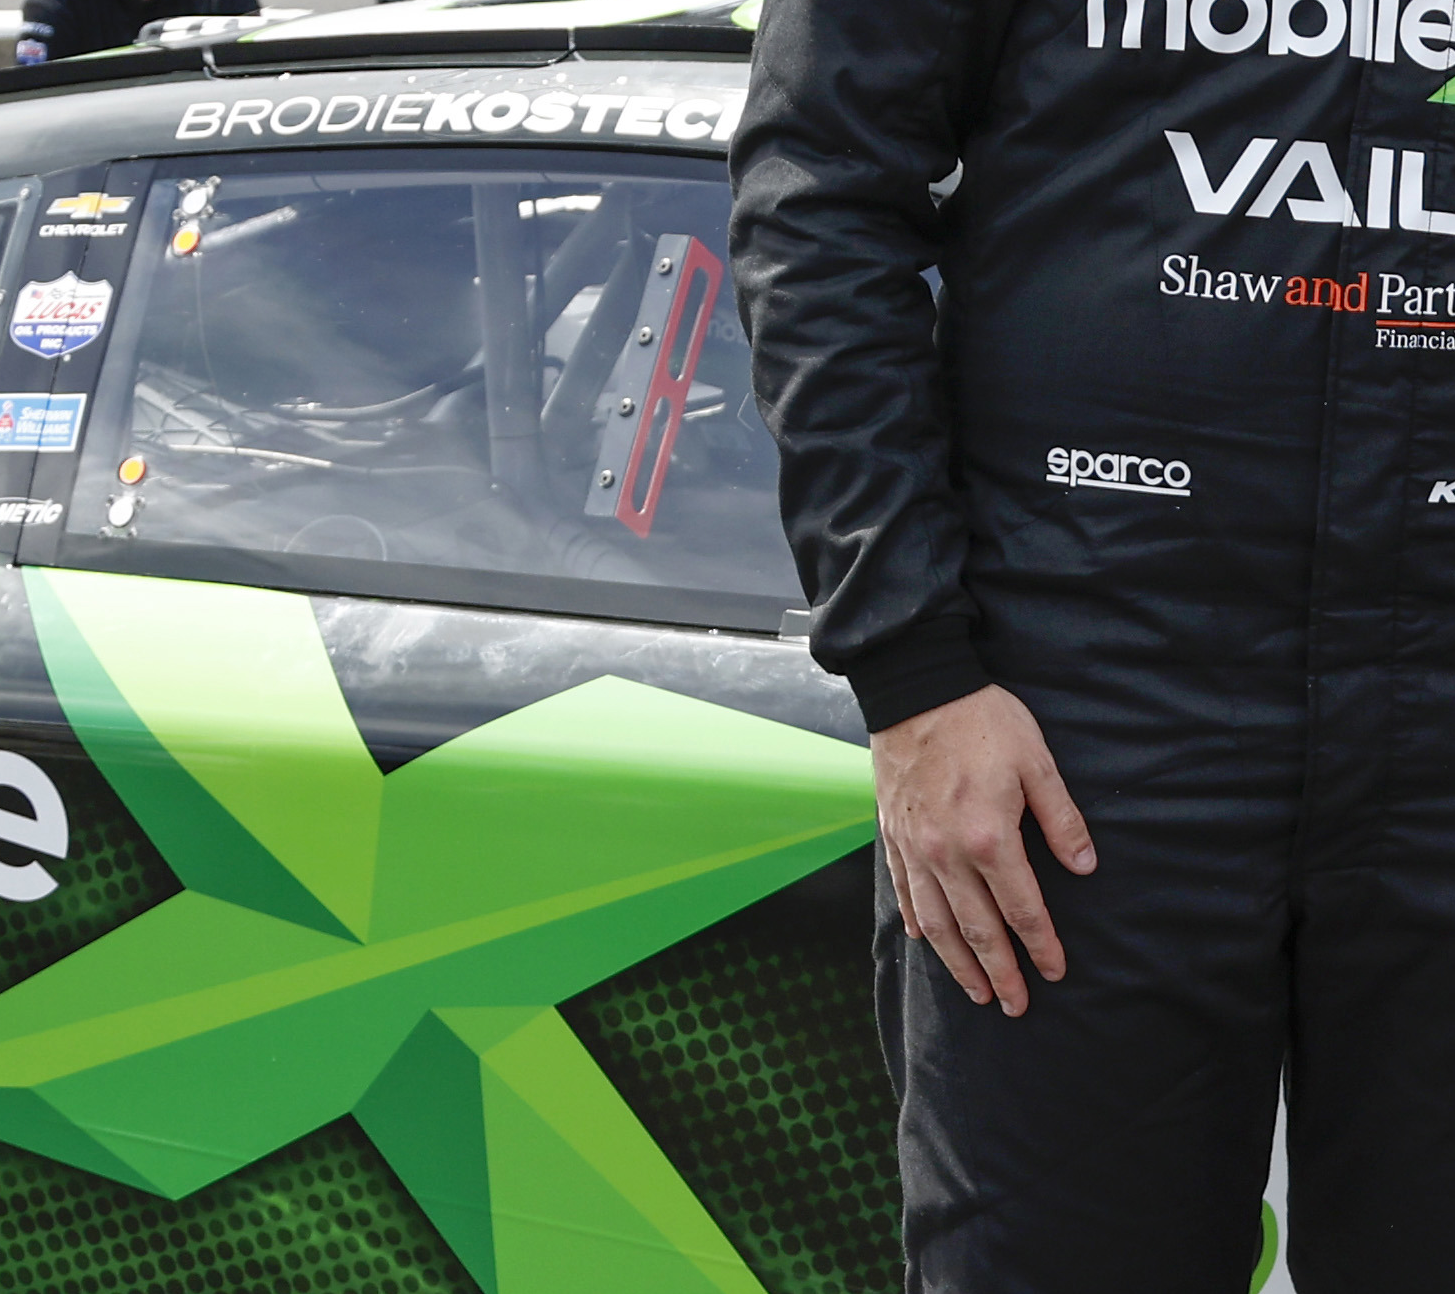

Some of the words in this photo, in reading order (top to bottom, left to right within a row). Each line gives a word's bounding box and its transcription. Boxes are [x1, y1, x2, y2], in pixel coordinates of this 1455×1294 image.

[39, 223, 128, 237] CHEVROLET
[25, 300, 103, 321] LUCAS
[14, 325, 35, 337] OIL
[36, 325, 98, 337] PRODUCTS
[1046, 447, 1191, 491] sparco
